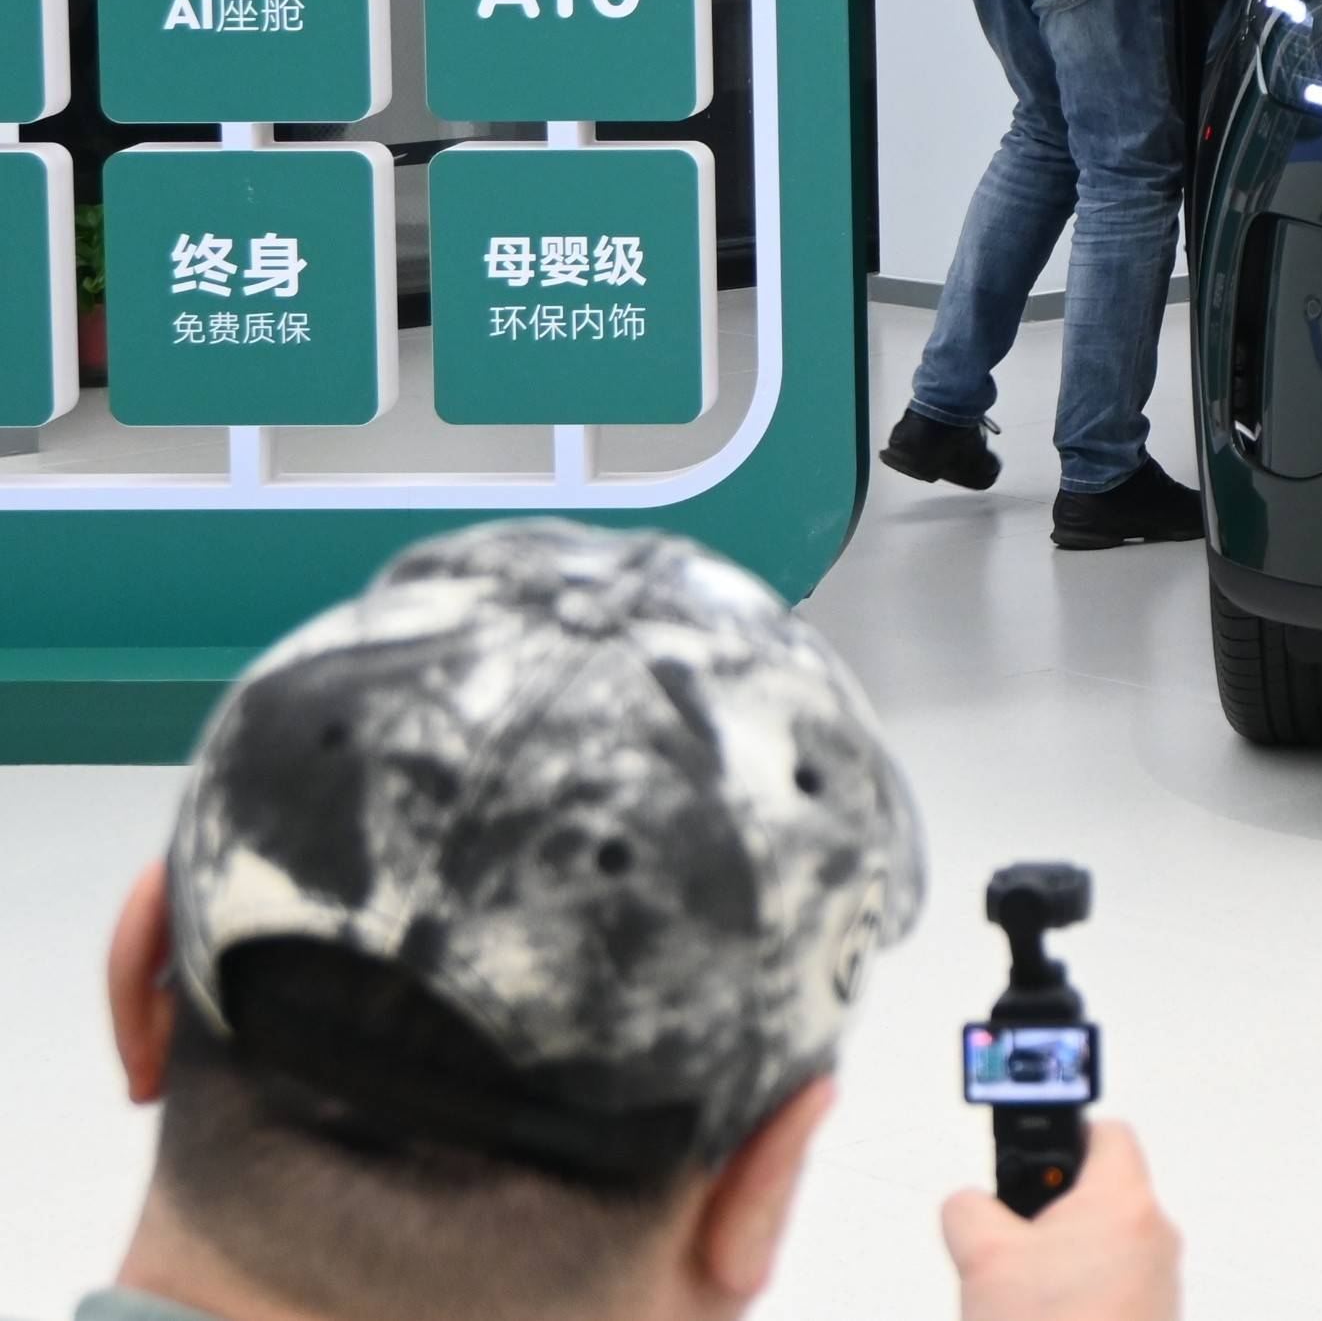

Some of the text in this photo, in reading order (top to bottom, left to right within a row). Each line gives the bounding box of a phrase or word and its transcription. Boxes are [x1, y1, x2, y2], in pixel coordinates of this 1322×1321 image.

[171, 233, 308, 297] 终身
[484, 235, 647, 287] 母婴级
[172, 311, 311, 345] 免费质保
[489, 302, 647, 341] 环保内饰
